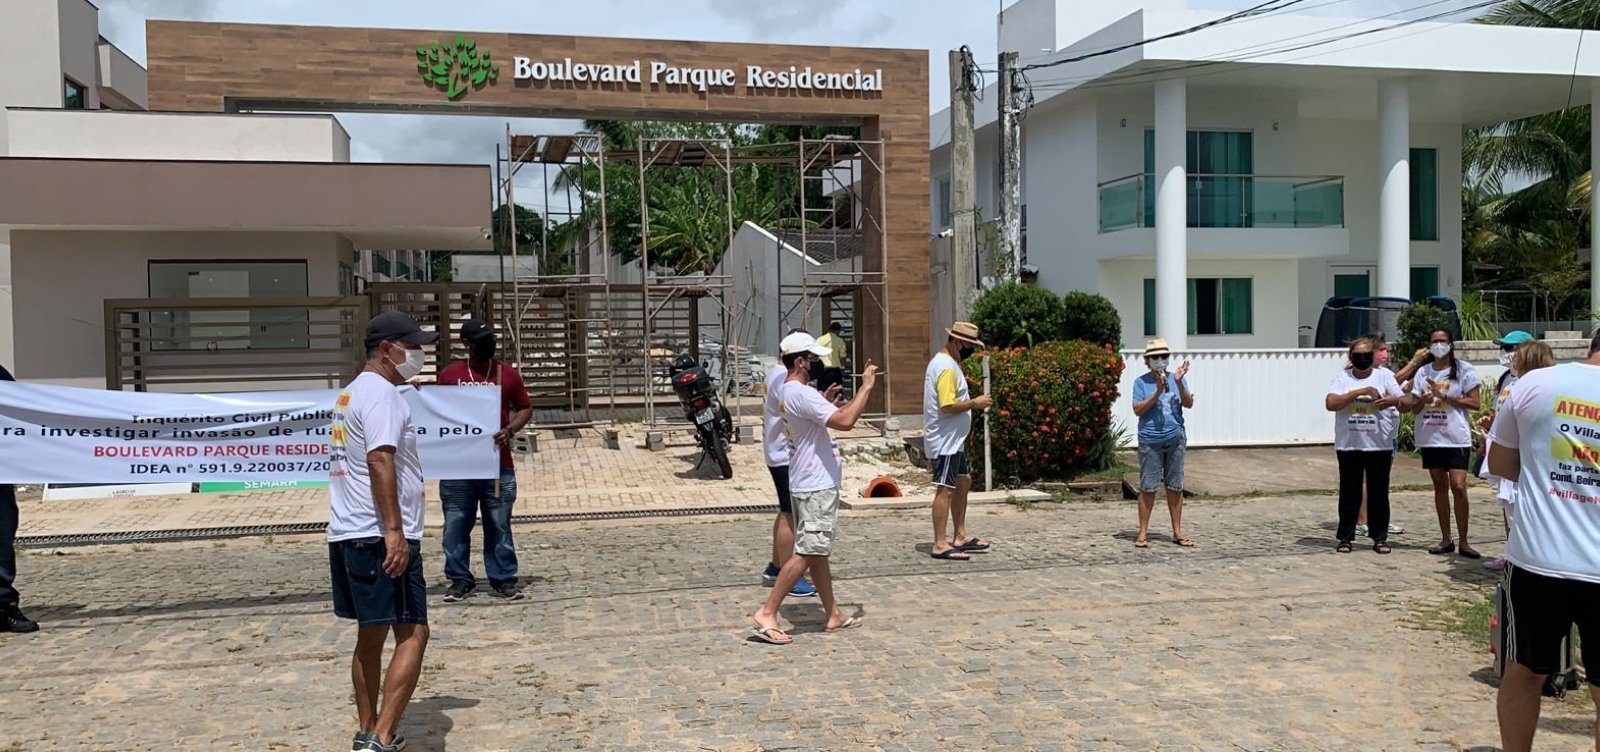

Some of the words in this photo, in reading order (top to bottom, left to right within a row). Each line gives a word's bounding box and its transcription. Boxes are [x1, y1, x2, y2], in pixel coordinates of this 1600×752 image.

[513, 56, 641, 83] Boulevard
[650, 62, 736, 91] Parque
[746, 65, 882, 91] Residencial
[232, 411, 271, 424] Civil
[41, 424, 160, 440] investigar
[173, 427, 256, 439] invasão
[268, 425, 293, 437] de
[439, 424, 483, 437] pelo
[1560, 423, 1570, 432] O
[94, 445, 197, 457] BOULEVARD
[203, 444, 270, 458] PARQUE
[275, 443, 329, 456] RESIDE
[129, 463, 171, 474] IDEA
[199, 460, 330, 474] 591.9.220037/20
[1559, 462, 1572, 471] faz
[1550, 471, 1575, 483] Cond.
